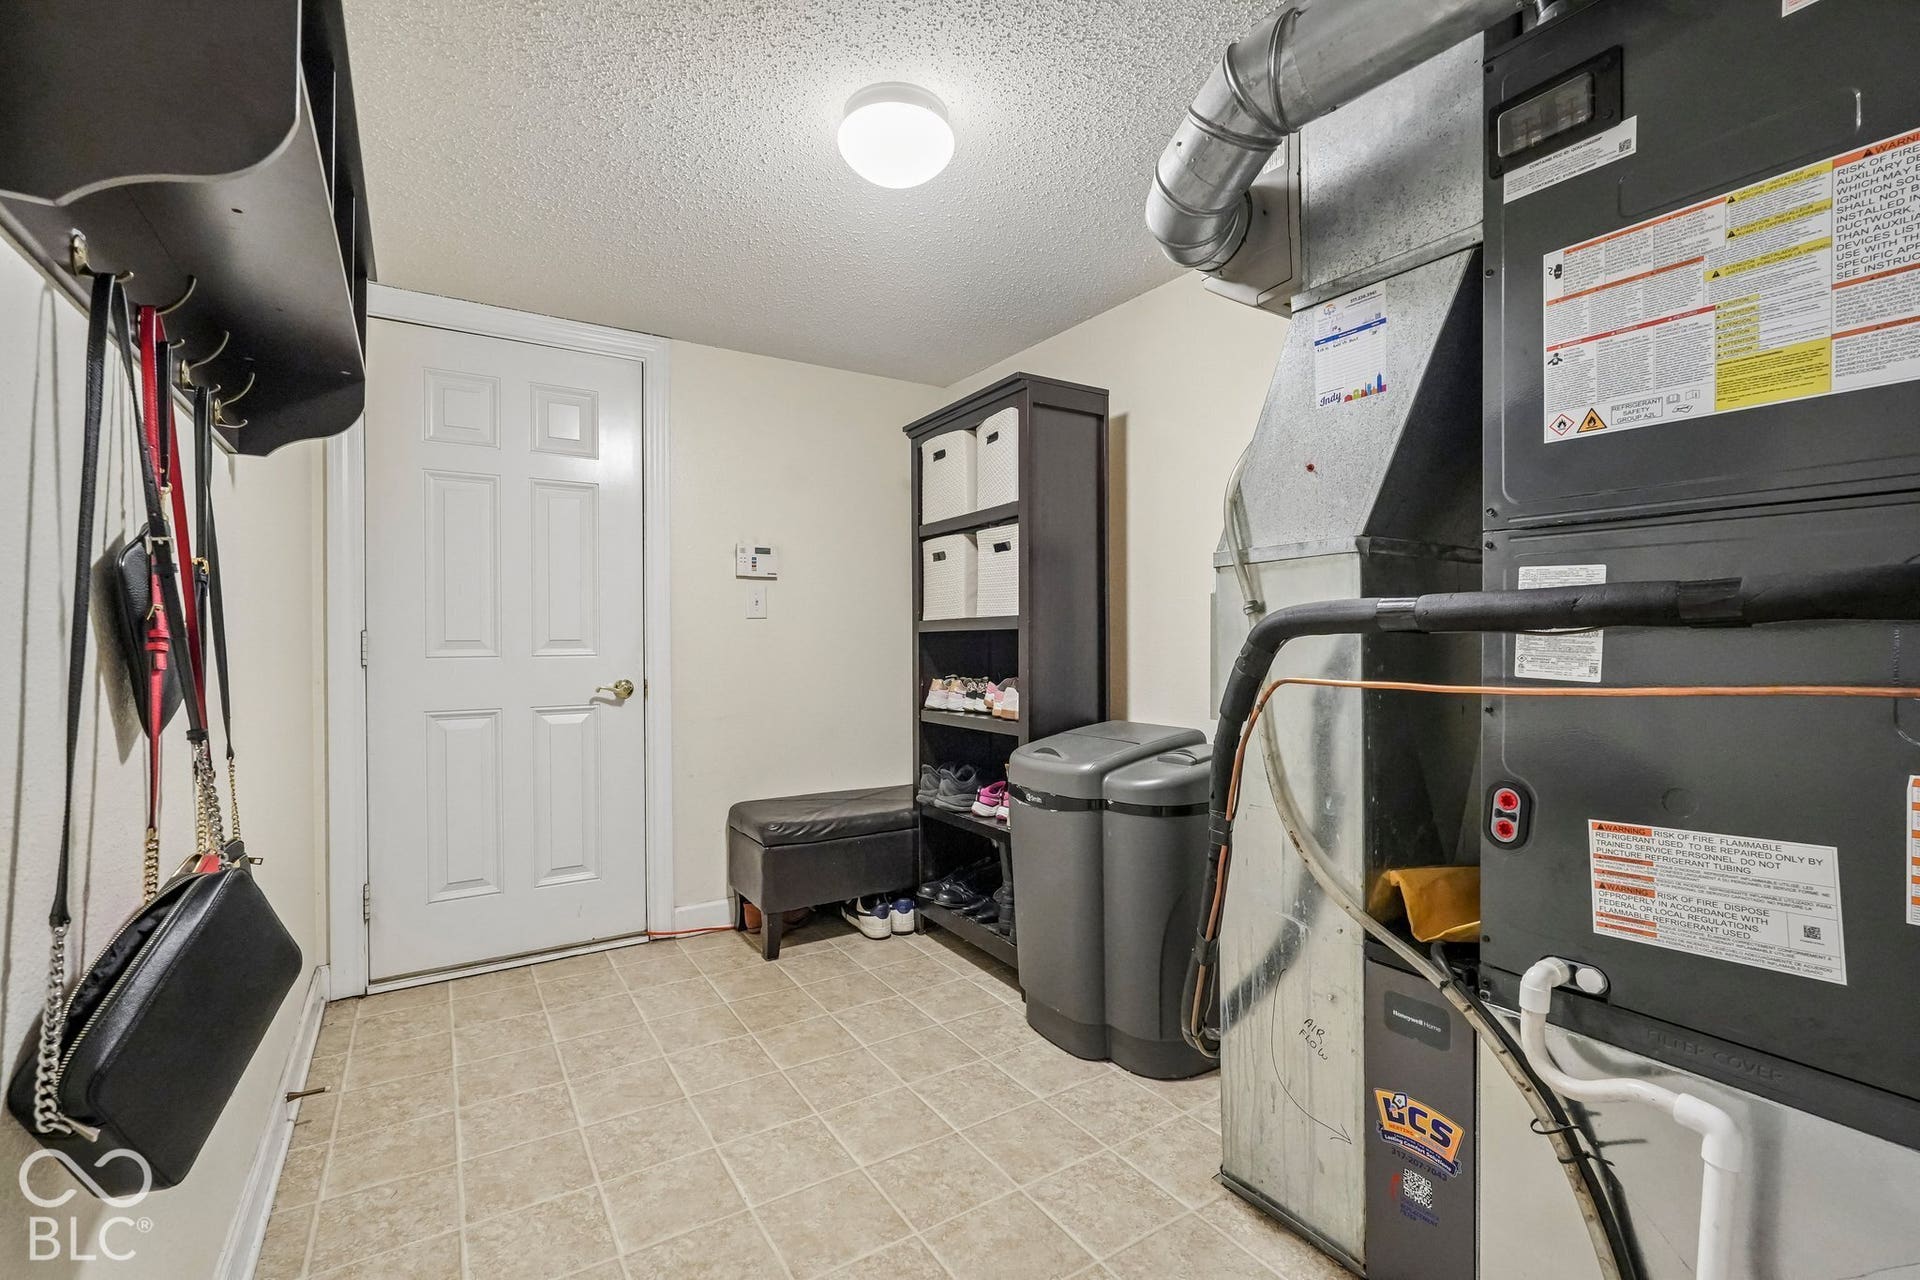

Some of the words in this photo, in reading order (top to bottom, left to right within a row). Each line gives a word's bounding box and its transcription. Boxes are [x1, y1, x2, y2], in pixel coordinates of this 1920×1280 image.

[1837, 161, 1865, 177] RISK
[1869, 154, 1887, 166] OF
[1891, 143, 1920, 159] FIRE
[1837, 159, 1902, 186] AUXILIARY
[1836, 176, 1878, 195] WHICH
[1883, 166, 1911, 181] MAY
[1836, 181, 1891, 205] IGNITION
[1836, 196, 1874, 214] SHALL
[1879, 186, 1906, 201] NOT
[1836, 197, 1905, 223] INSTALLED
[1836, 204, 1914, 233] DUCTWORK.
[1836, 226, 1868, 242] THAN
[1836, 230, 1890, 251] DEVICES
[1836, 248, 1860, 261] USE
[1864, 238, 1897, 253] WITH
[1836, 249, 1892, 270] SPECIFIC
[1836, 267, 1860, 280] SEE
[1319, 391, 1342, 407] Indy
[1611, 398, 1659, 411] REFRIGERANT
[1622, 406, 1649, 416] SAFETY
[1616, 414, 1641, 424] GROUP
[1595, 831, 1654, 844] REFRIGERANT
[1688, 842, 1701, 850] TO
[1704, 844, 1716, 852] BE
[1719, 846, 1772, 860] REPAIRED
[1774, 853, 1805, 864] ONLY
[1808, 857, 1823, 866] BY
[1604, 824, 1645, 835] WARNING
[1654, 830, 1674, 839] RISK
[1677, 833, 1691, 841] OF
[1719, 838, 1782, 852] FLAMMABLE
[1596, 839, 1632, 849] TRAINED
[1634, 844, 1672, 855] SERVICE
[1740, 857, 1755, 866] DO
[1758, 860, 1781, 870] NOT
[1596, 846, 1642, 858] PUNCTURE
[1644, 853, 1710, 868] REFRIGERANT
[1598, 897, 1636, 910] FEDERAL
[1639, 904, 1652, 913] OR
[1654, 907, 1685, 919] LOCAL
[1606, 882, 1648, 896] WARNING
[1657, 892, 1678, 901] RISK
[1680, 895, 1694, 904] OF
[1723, 902, 1770, 917] DISPOSE
[1598, 905, 1652, 921] FLAMMABLE
[1652, 915, 1721, 934] REFRIGERANT
[1658, 900, 1667, 908] IN
[1669, 902, 1738, 920] ACCORDANCE
[1740, 914, 1768, 925] WITH
[1304, 1018, 1326, 1045] AIR
[1392, 1008, 1423, 1026] Honeywell
[1424, 1019, 1442, 1033] Home
[1299, 1029, 1328, 1061] FLOW
